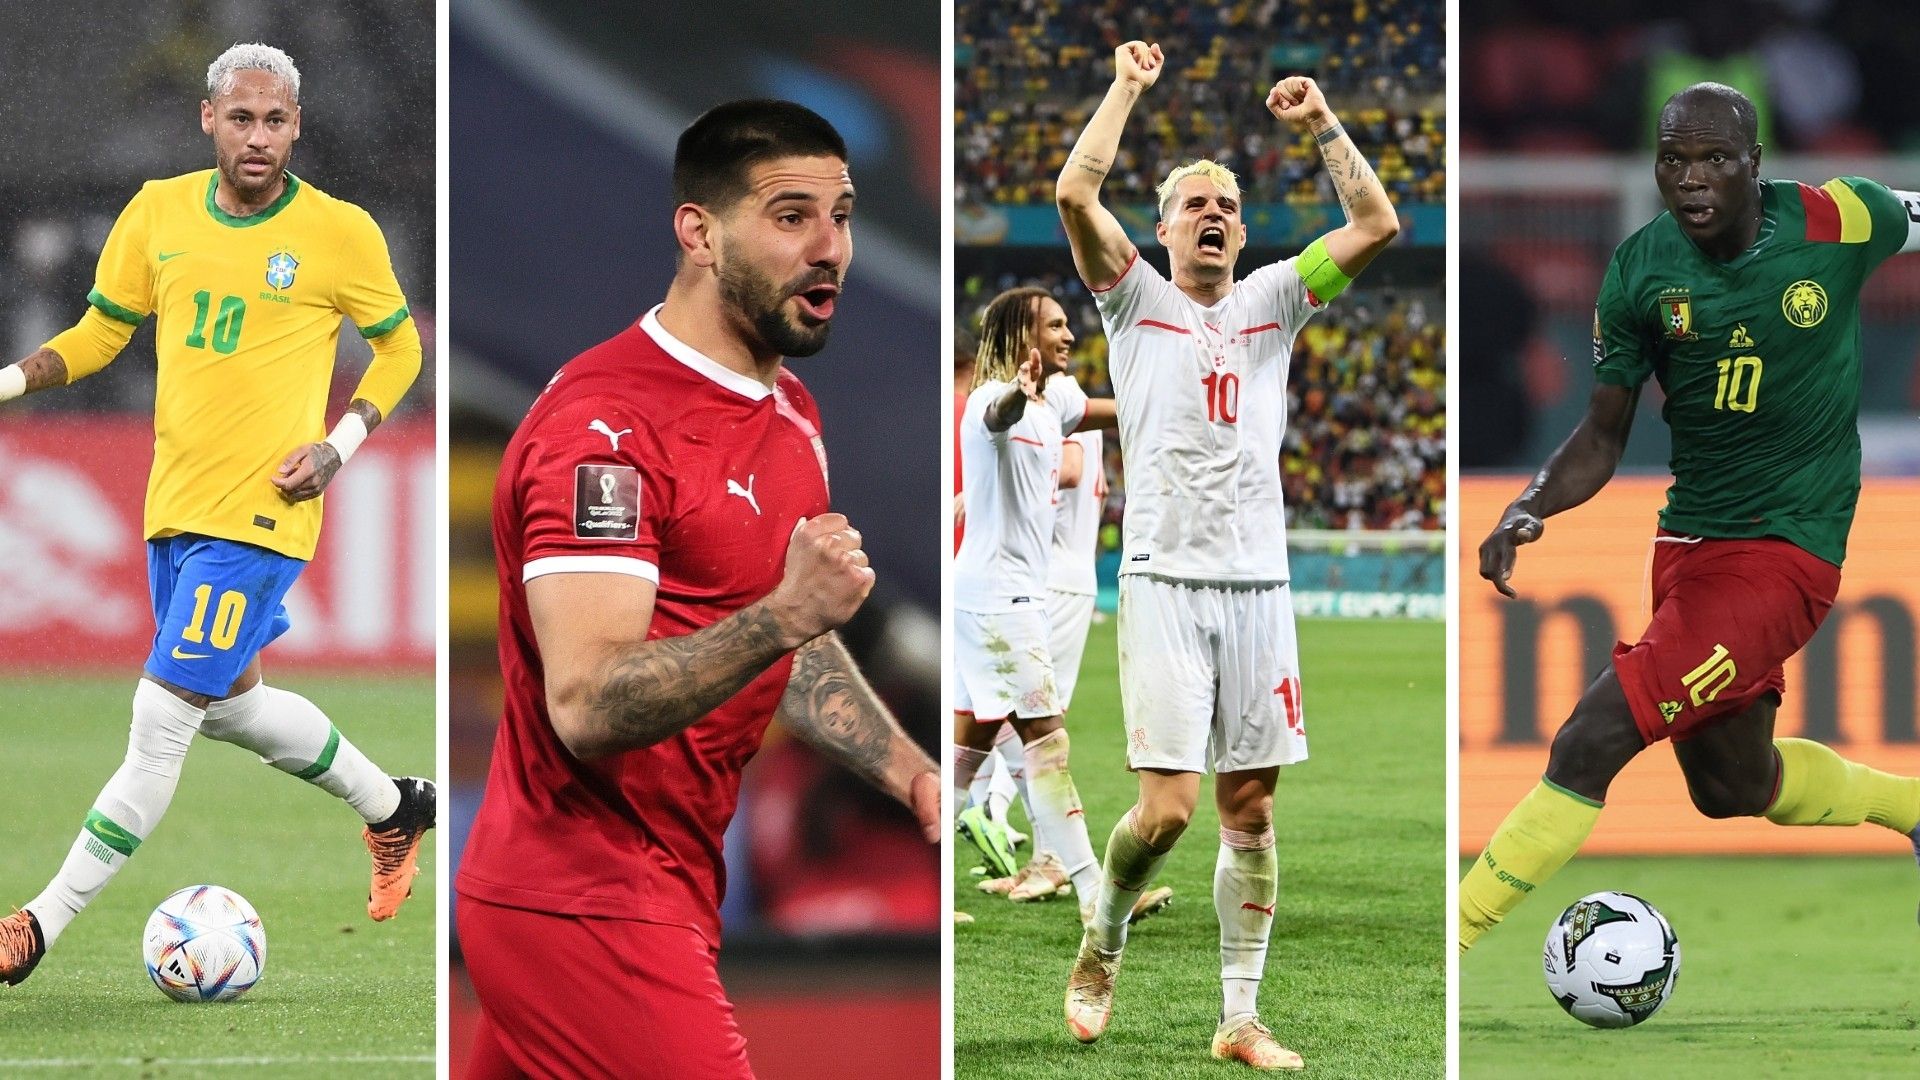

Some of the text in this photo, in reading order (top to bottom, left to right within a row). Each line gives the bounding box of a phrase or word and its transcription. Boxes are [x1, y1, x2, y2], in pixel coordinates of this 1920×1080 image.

[185, 289, 246, 355] 10
[259, 292, 292, 304] BRASIL
[1200, 371, 1239, 424] 10
[1714, 356, 1763, 413] 10
[585, 519, 628, 530] Qualifiers
[182, 584, 247, 651] 10
[1681, 643, 1736, 707] 10
[84, 837, 115, 865] BRASIL
